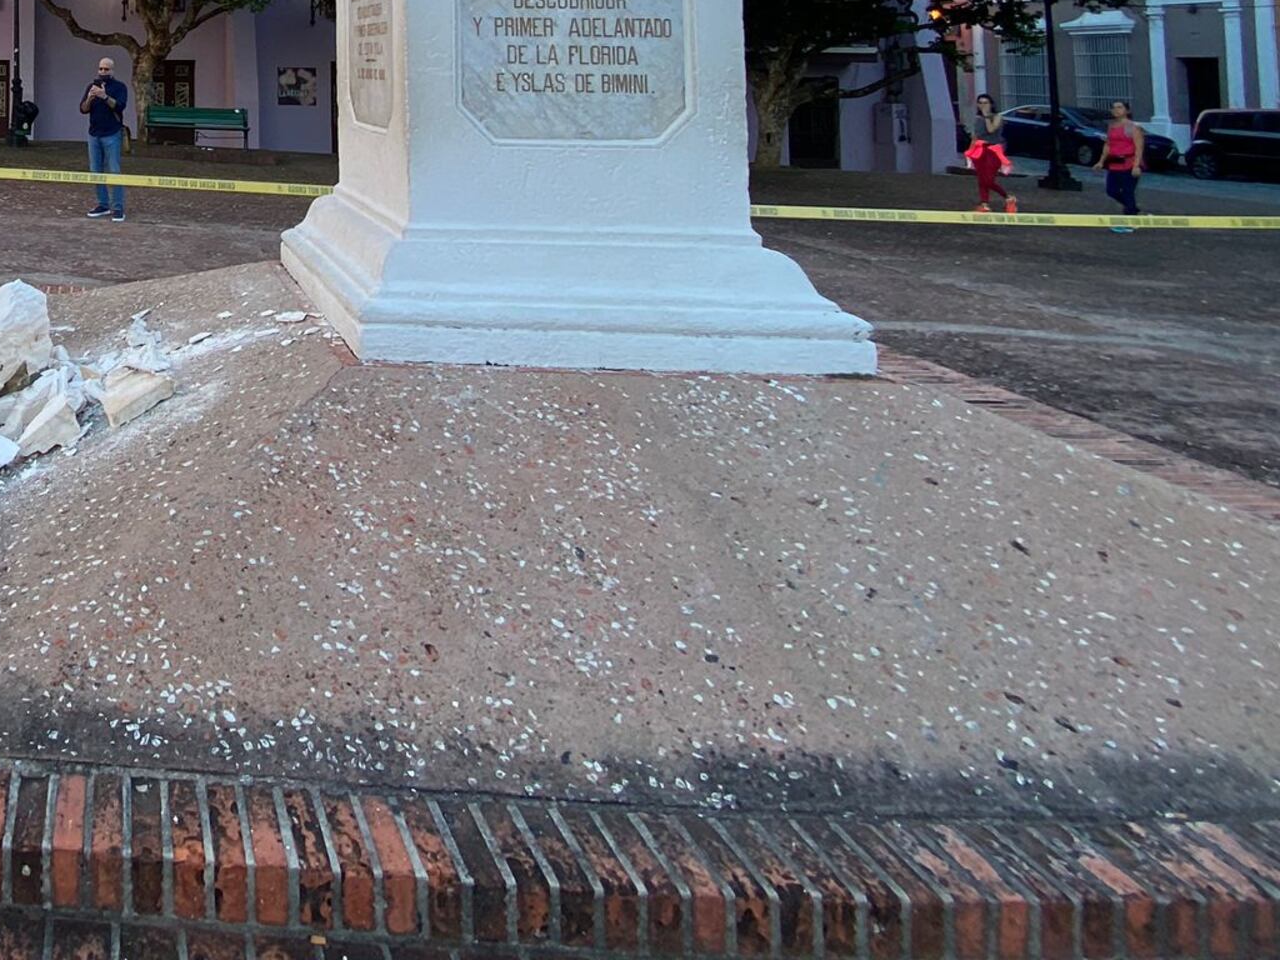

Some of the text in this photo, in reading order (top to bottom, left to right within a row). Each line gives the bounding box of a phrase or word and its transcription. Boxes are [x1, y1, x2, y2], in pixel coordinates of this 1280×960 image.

[473, 17, 672, 38] Y PRIMER ADELANTADO
[507, 45, 638, 65] DE LA FLORIDA
[496, 73, 655, 94] E YSLAS DE BIMINI.
